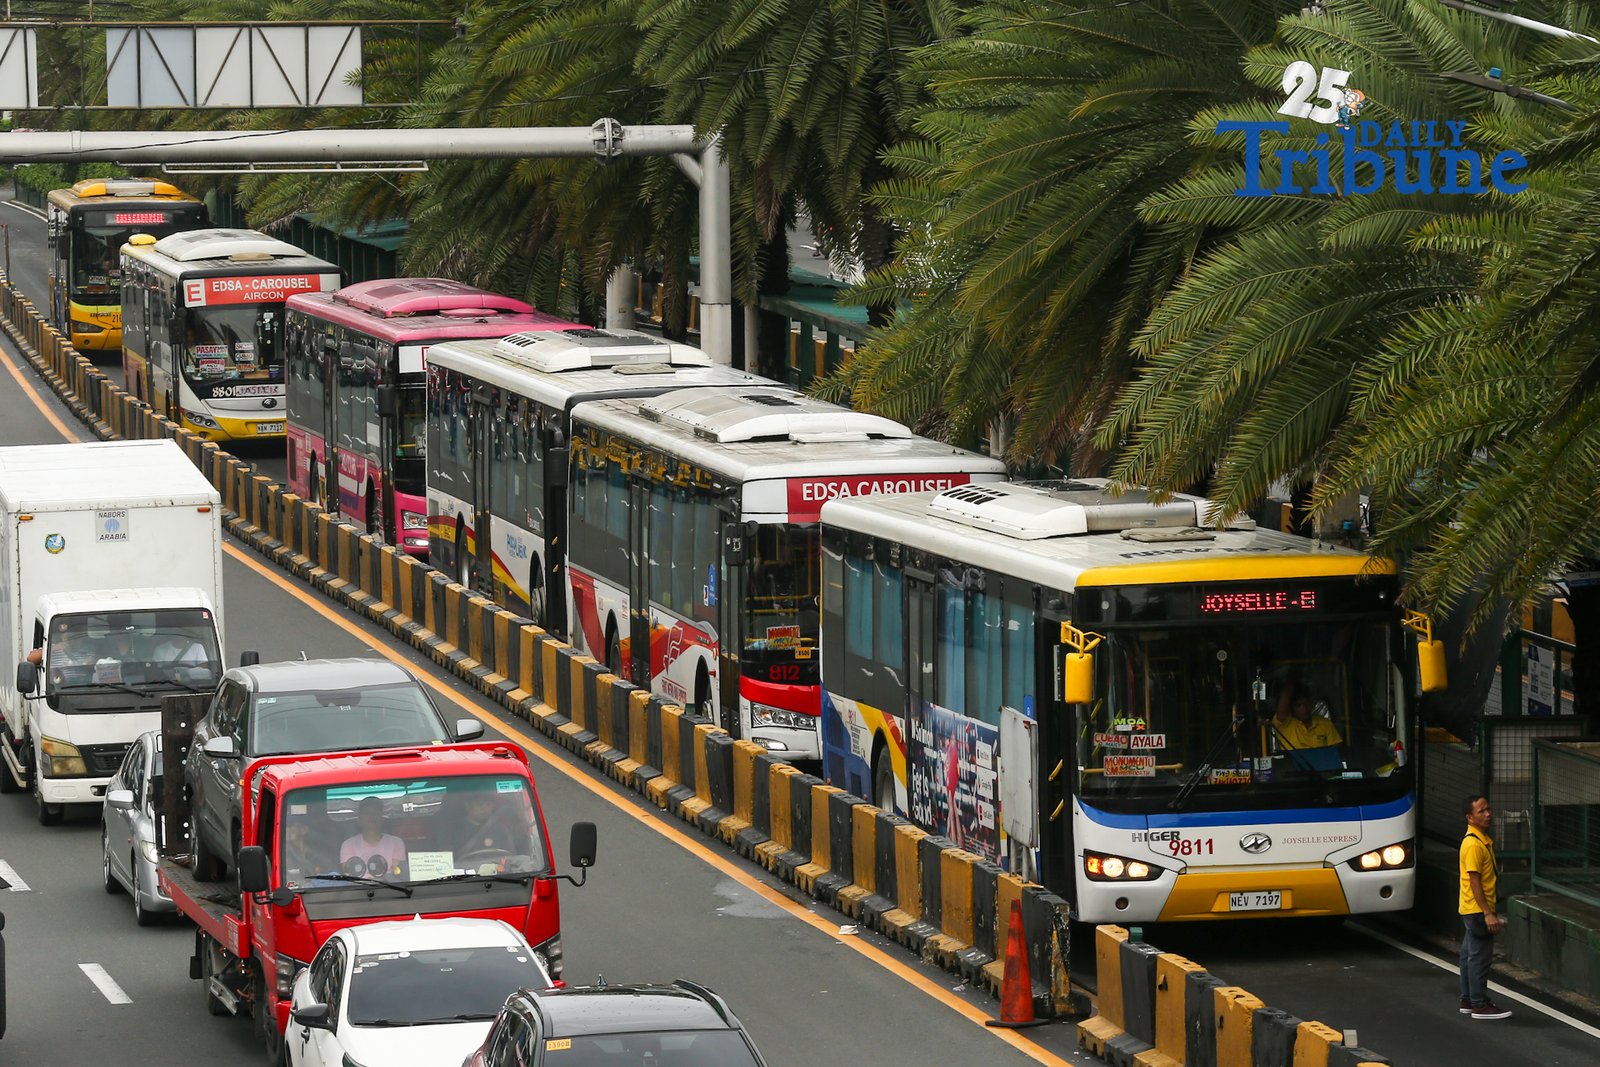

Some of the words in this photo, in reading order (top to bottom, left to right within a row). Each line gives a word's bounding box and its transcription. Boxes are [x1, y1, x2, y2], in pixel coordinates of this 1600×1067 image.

[212, 279, 243, 292] EDSA
[252, 277, 312, 290] CAROUSEL
[243, 291, 284, 300] AIRCON
[196, 346, 216, 354] PASAY
[212, 386, 236, 397] 8801
[802, 482, 852, 501] EDSA
[769, 665, 800, 681] 812
[1094, 733, 1128, 745] CUBAO
[1132, 735, 1164, 748] AYALA
[1104, 756, 1154, 768] MONUMENTO
[1131, 831, 1181, 843] HIGER
[1282, 836, 1322, 845] JOYSELLE
[1323, 835, 1358, 843] EXPRESS
[1169, 838, 1214, 856] 9811
[1231, 895, 1249, 907] NEV
[1256, 894, 1280, 907] 7197
